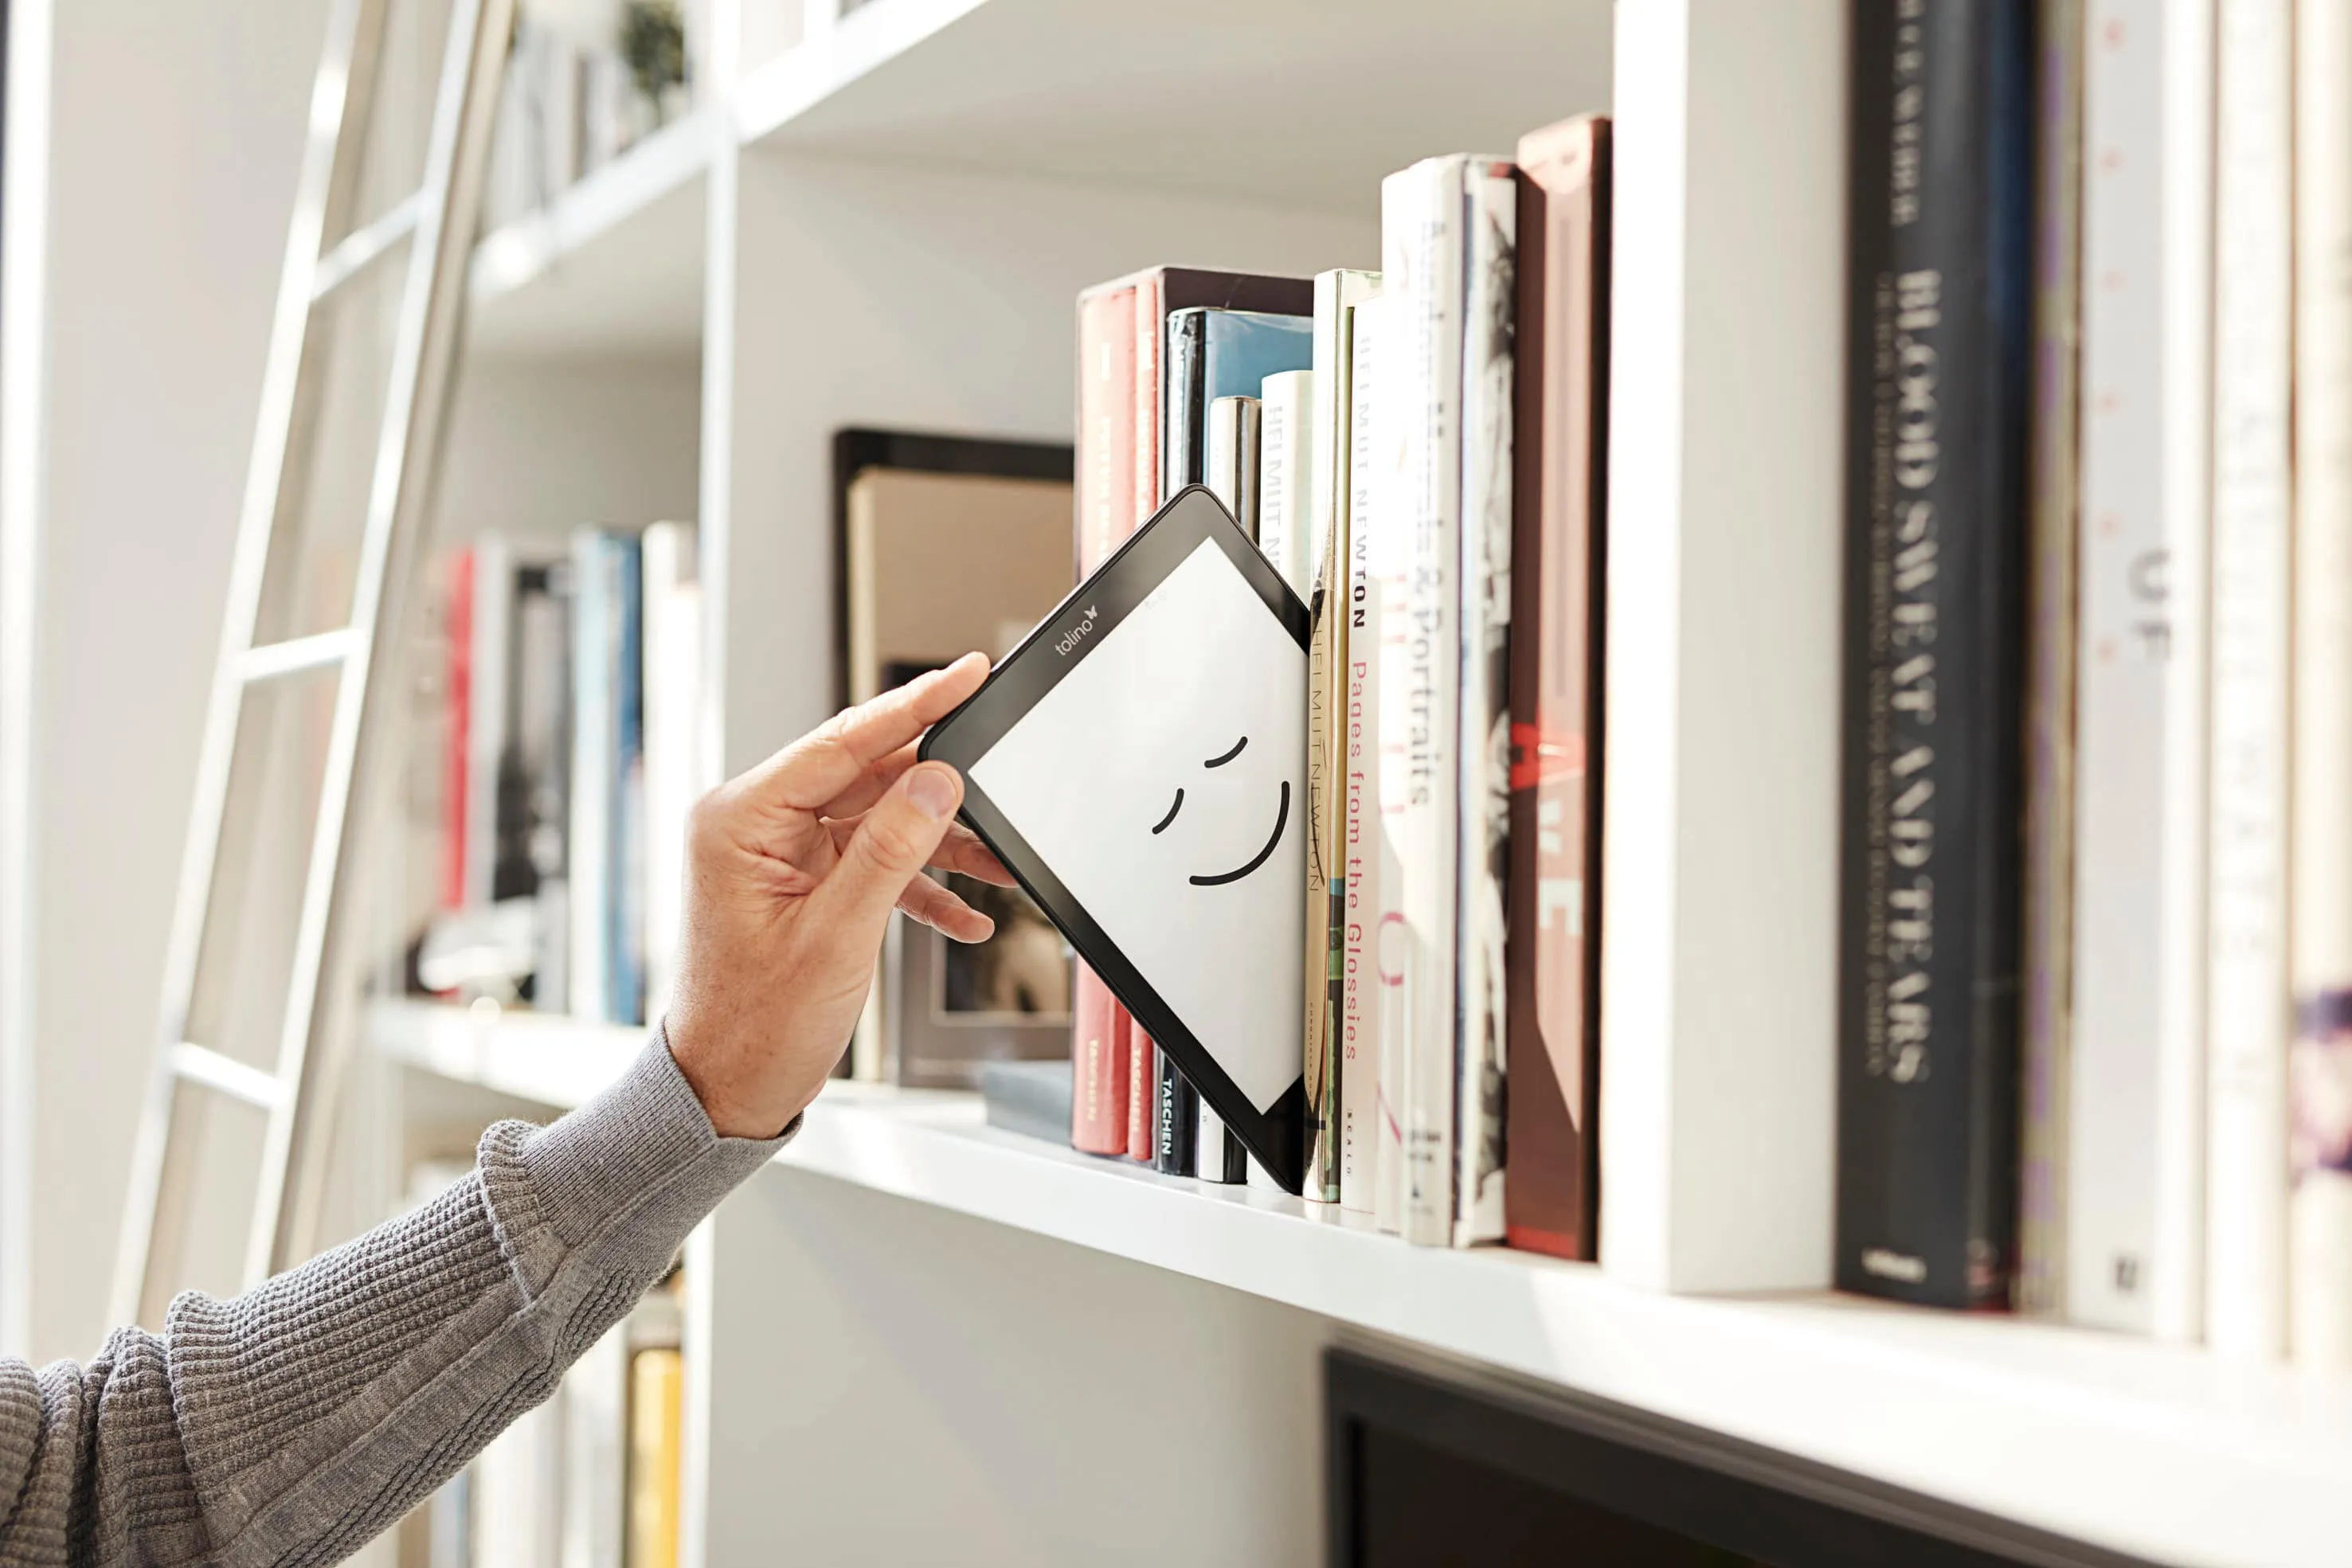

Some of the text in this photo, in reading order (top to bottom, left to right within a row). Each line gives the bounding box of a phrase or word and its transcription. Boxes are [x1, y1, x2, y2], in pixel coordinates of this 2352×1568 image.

[1265, 405, 1283, 528] HELMUT
[1353, 487, 1368, 629] NEWTON
[1055, 620, 1093, 655] tolino
[1886, 269, 1942, 1083] BLOOD SWEAT AND TEARS
[1309, 631, 1324, 893] HELMUT NEWTON
[1350, 661, 1368, 758] Pages
[1411, 608, 1443, 807] Portraits
[1348, 769, 1364, 844] from
[1348, 858, 1363, 909] the
[1346, 924, 1361, 1060] Glossies
[1132, 1046, 1142, 1132] TASCHEN
[1162, 1078, 1173, 1155] TASCHEN
